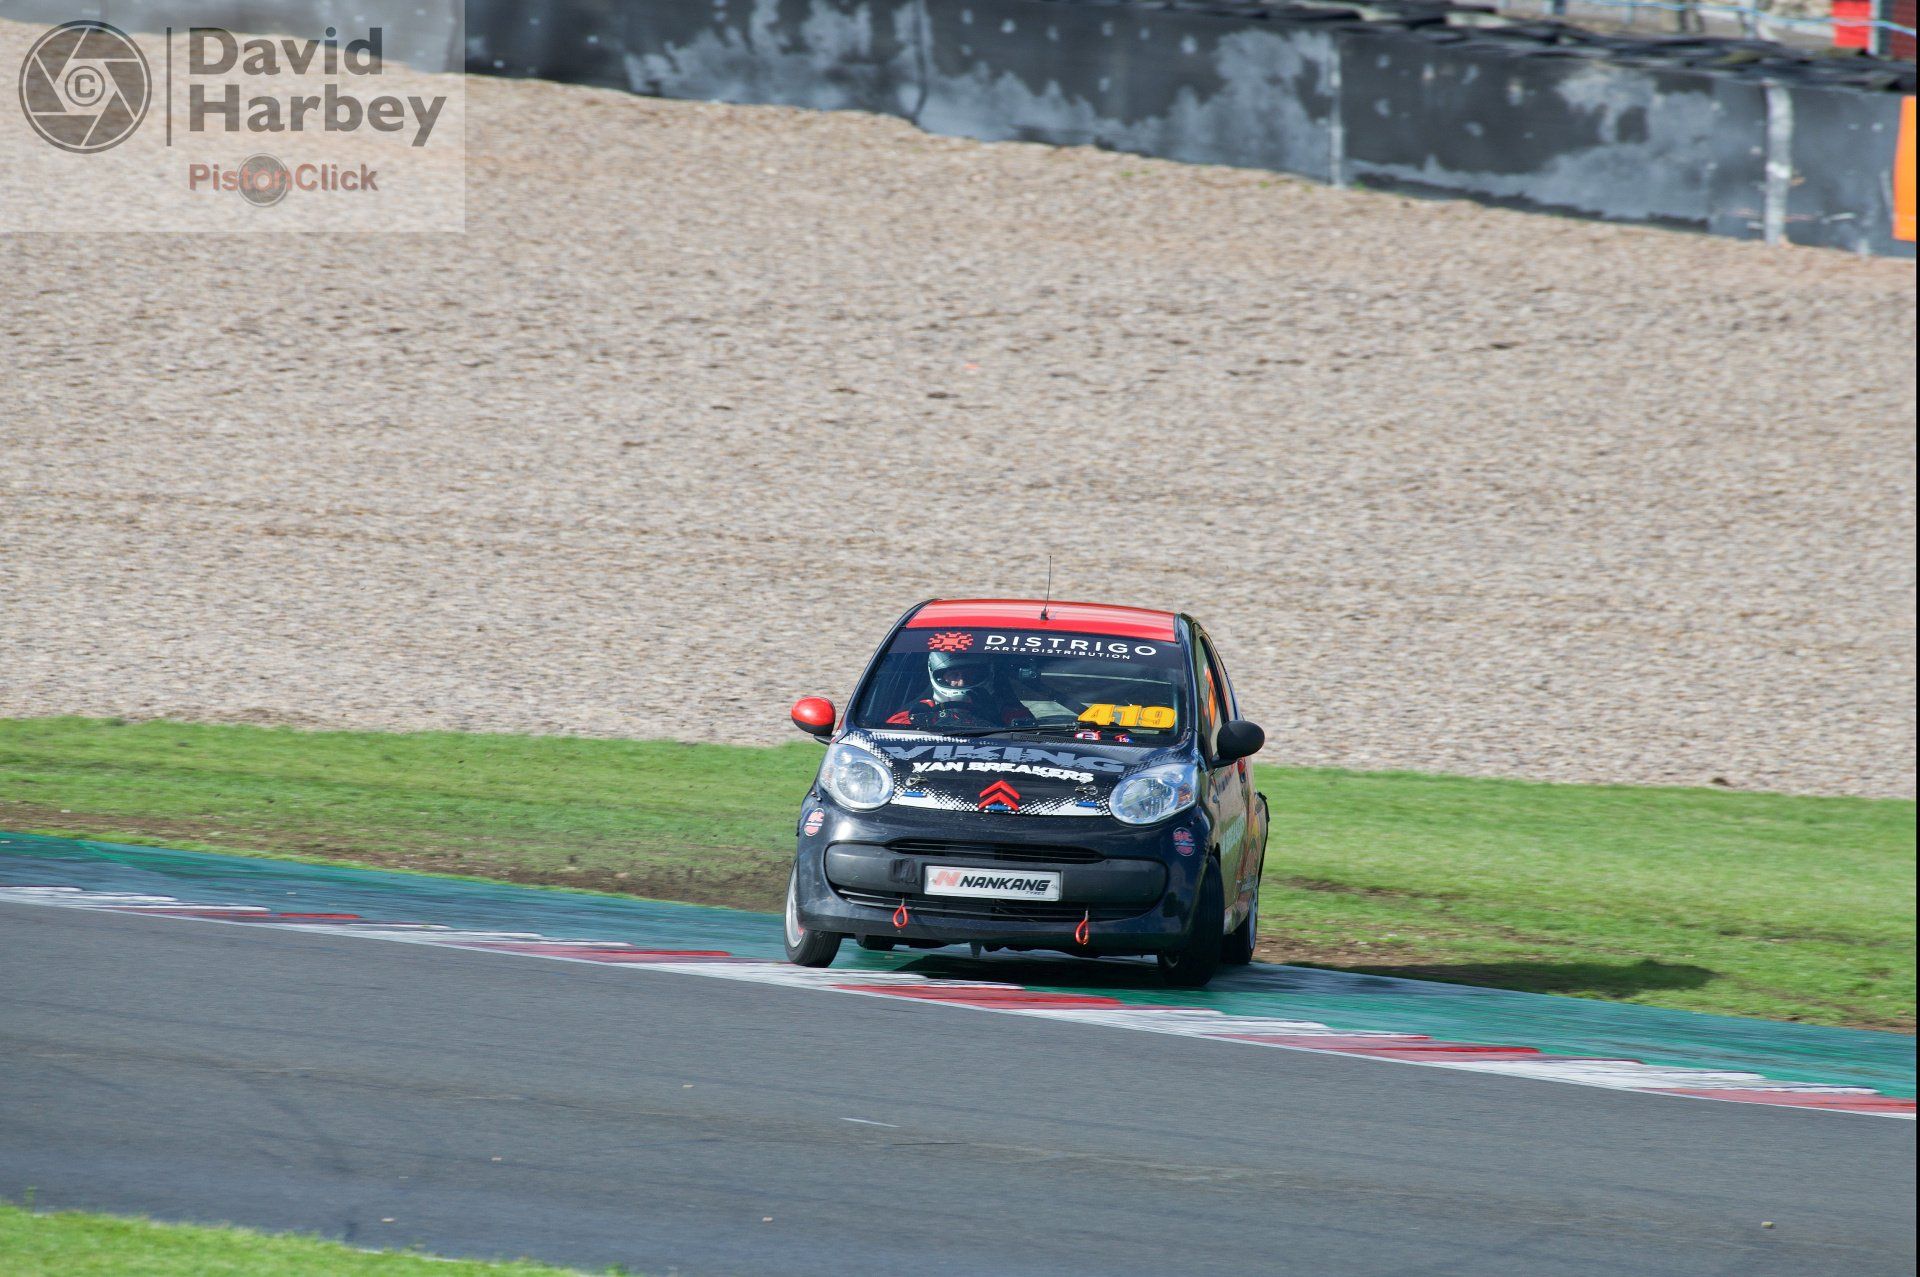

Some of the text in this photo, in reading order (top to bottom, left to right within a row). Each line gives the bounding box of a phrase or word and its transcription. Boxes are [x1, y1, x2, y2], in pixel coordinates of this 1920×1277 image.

[986, 634, 1157, 656] DISTRIGO
[1031, 648, 1131, 660] DISTRIBUTION
[1077, 703, 1176, 729] 419
[882, 745, 1125, 773] VIKING
[912, 761, 1095, 784] VAN BREAKERS
[959, 875, 1051, 892] NANKANG
